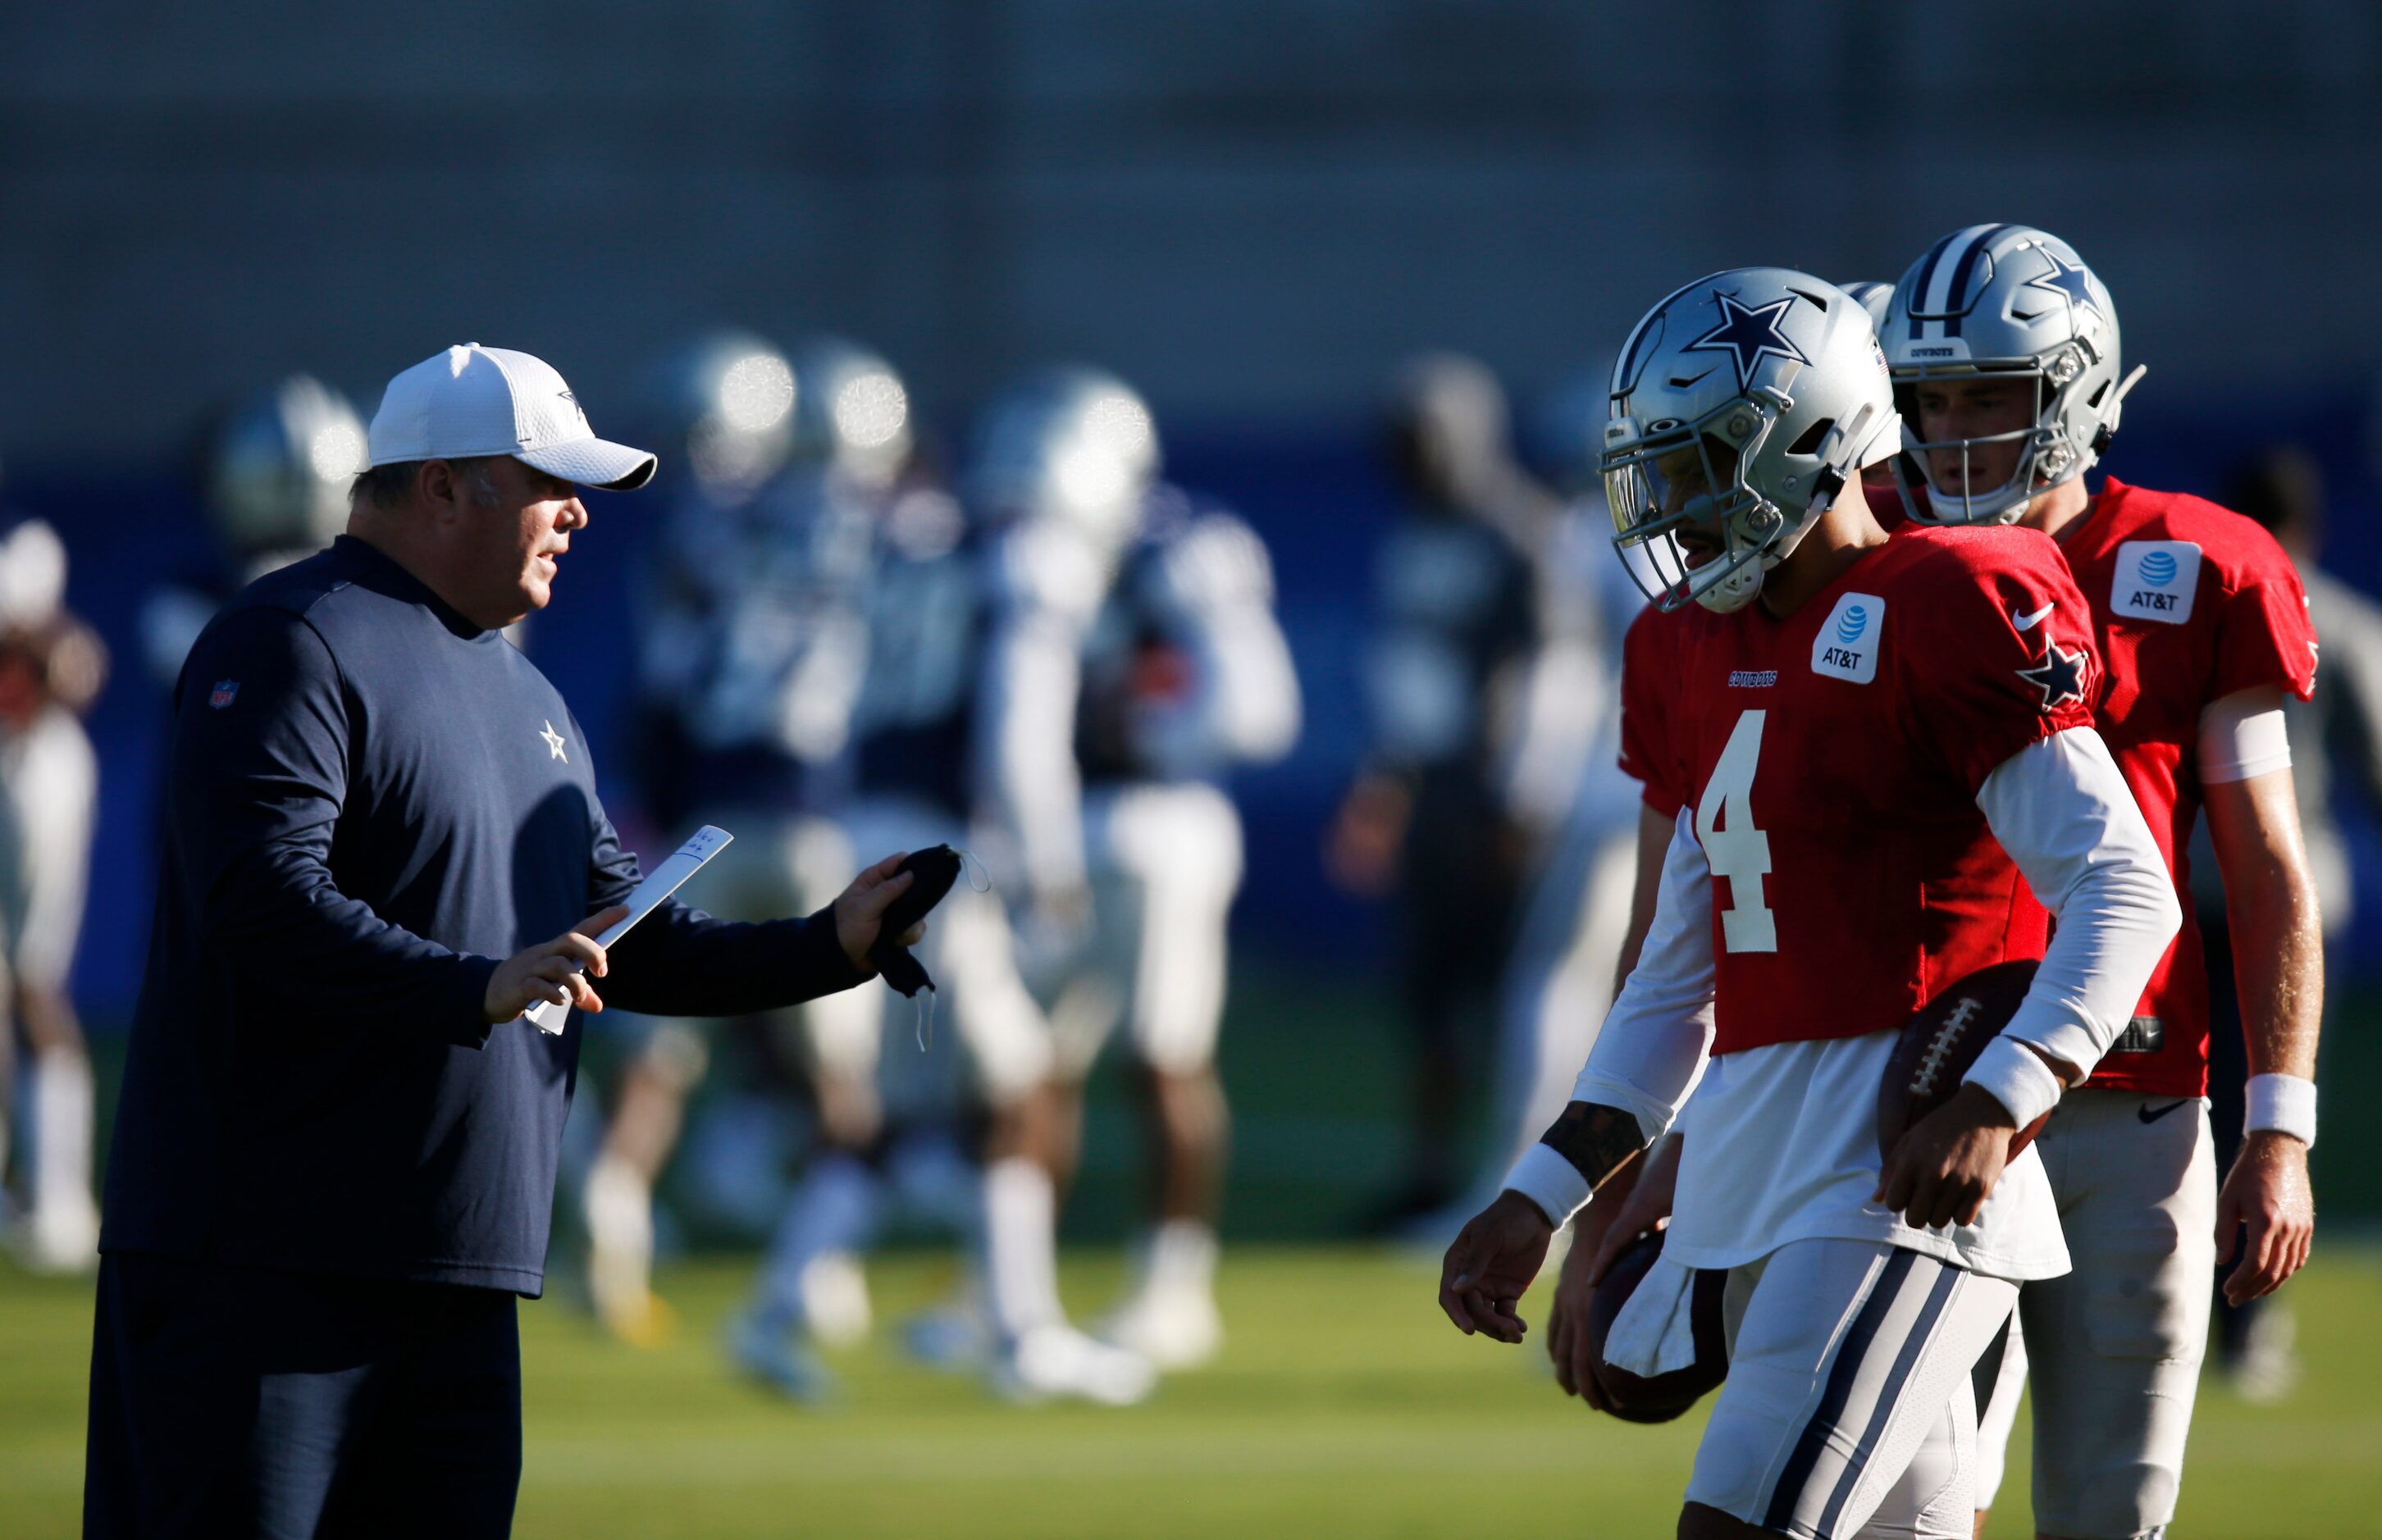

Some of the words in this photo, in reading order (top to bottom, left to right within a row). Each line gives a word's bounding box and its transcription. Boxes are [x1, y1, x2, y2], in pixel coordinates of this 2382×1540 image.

[2129, 590, 2179, 611] AT&T
[1822, 647, 1862, 670] AT&T
[1728, 671, 1777, 687] COWBOYS
[1696, 709, 1777, 953] 4
